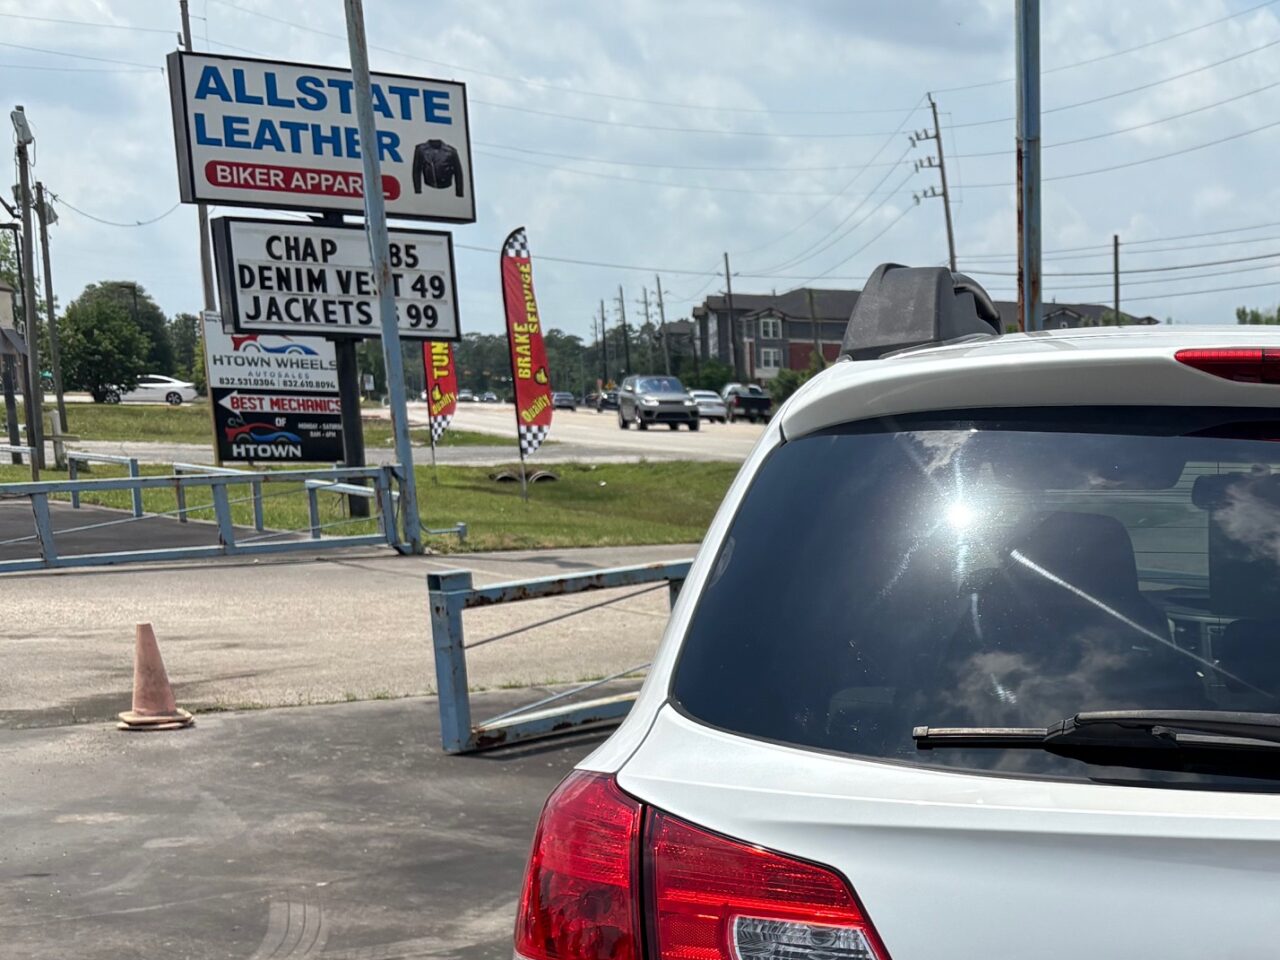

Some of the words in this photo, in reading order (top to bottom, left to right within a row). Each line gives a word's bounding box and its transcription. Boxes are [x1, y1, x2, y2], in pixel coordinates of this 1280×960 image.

[195, 65, 452, 125] ALLSTATE
[194, 113, 404, 163] LEATHER
[216, 165, 285, 188] BIKER
[291, 171, 390, 196] APPAR
[266, 235, 337, 263] CHAP
[389, 243, 419, 269] 85
[238, 264, 327, 293] DENIM
[411, 274, 445, 299] 49
[245, 295, 373, 325] JACKETS
[406, 304, 438, 328] 99
[519, 263, 539, 334] SERVICE
[212, 355, 271, 367] HTOWN
[275, 358, 338, 371] WHEELS
[514, 322, 531, 379] BRAKE
[230, 396, 265, 410] BEST
[269, 398, 342, 412] MECHANICS
[521, 393, 550, 423] Quality
[275, 417, 287, 427] OF
[232, 444, 302, 458] HTOWN
